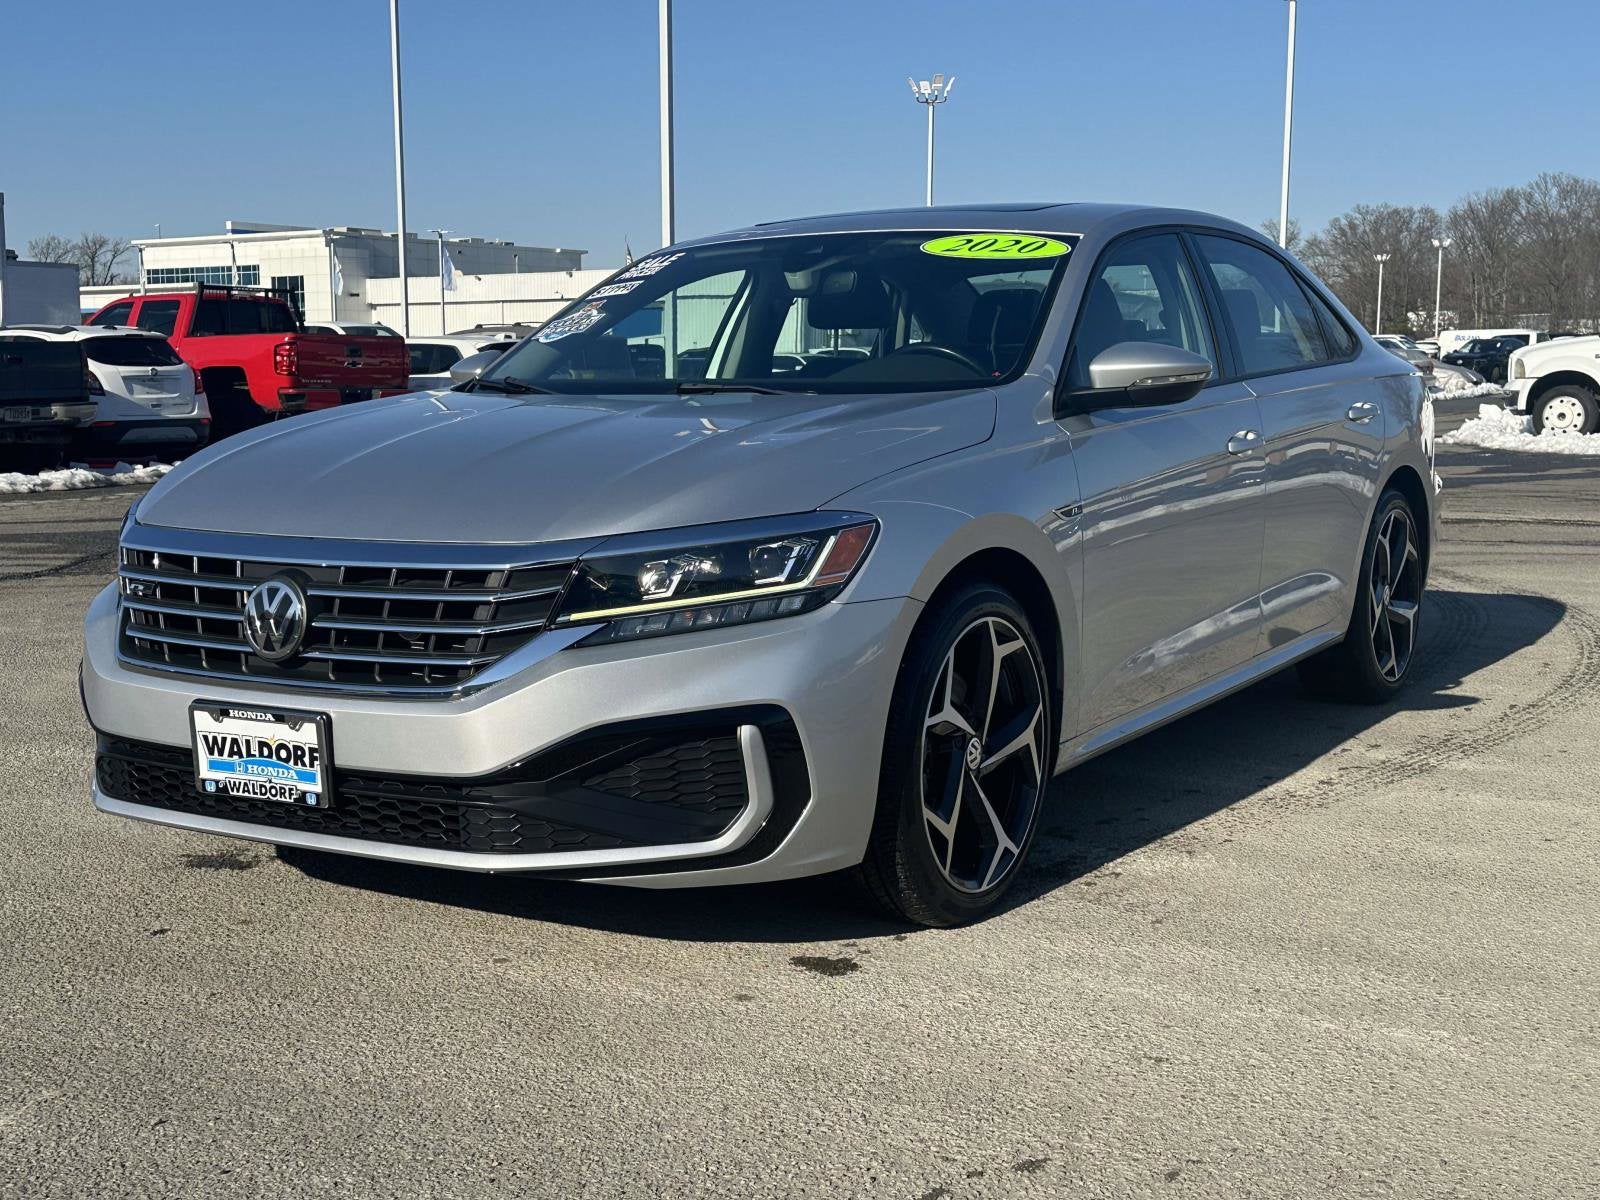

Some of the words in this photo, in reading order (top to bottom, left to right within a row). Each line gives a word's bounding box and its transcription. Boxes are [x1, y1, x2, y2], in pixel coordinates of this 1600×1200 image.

[940, 238, 1048, 254] 2020
[228, 709, 275, 722] HONDA
[202, 734, 320, 769] WALDORF
[247, 764, 299, 780] HONDA
[228, 780, 296, 800] WALDORF
